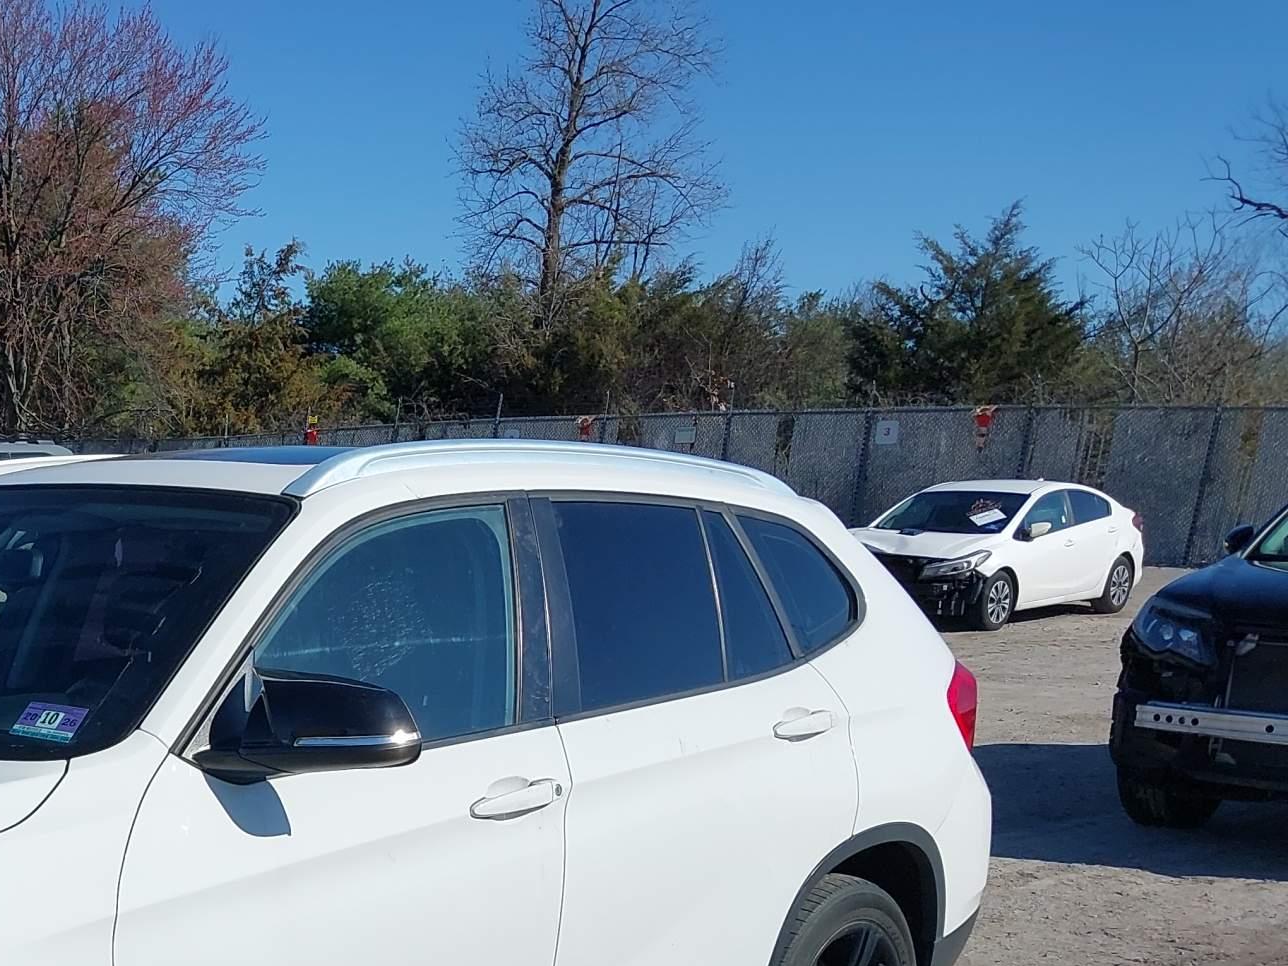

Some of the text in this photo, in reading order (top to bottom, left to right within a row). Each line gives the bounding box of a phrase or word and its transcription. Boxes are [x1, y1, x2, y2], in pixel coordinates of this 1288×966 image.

[883, 427, 891, 437] 3
[23, 711, 78, 727] 20 10 26
